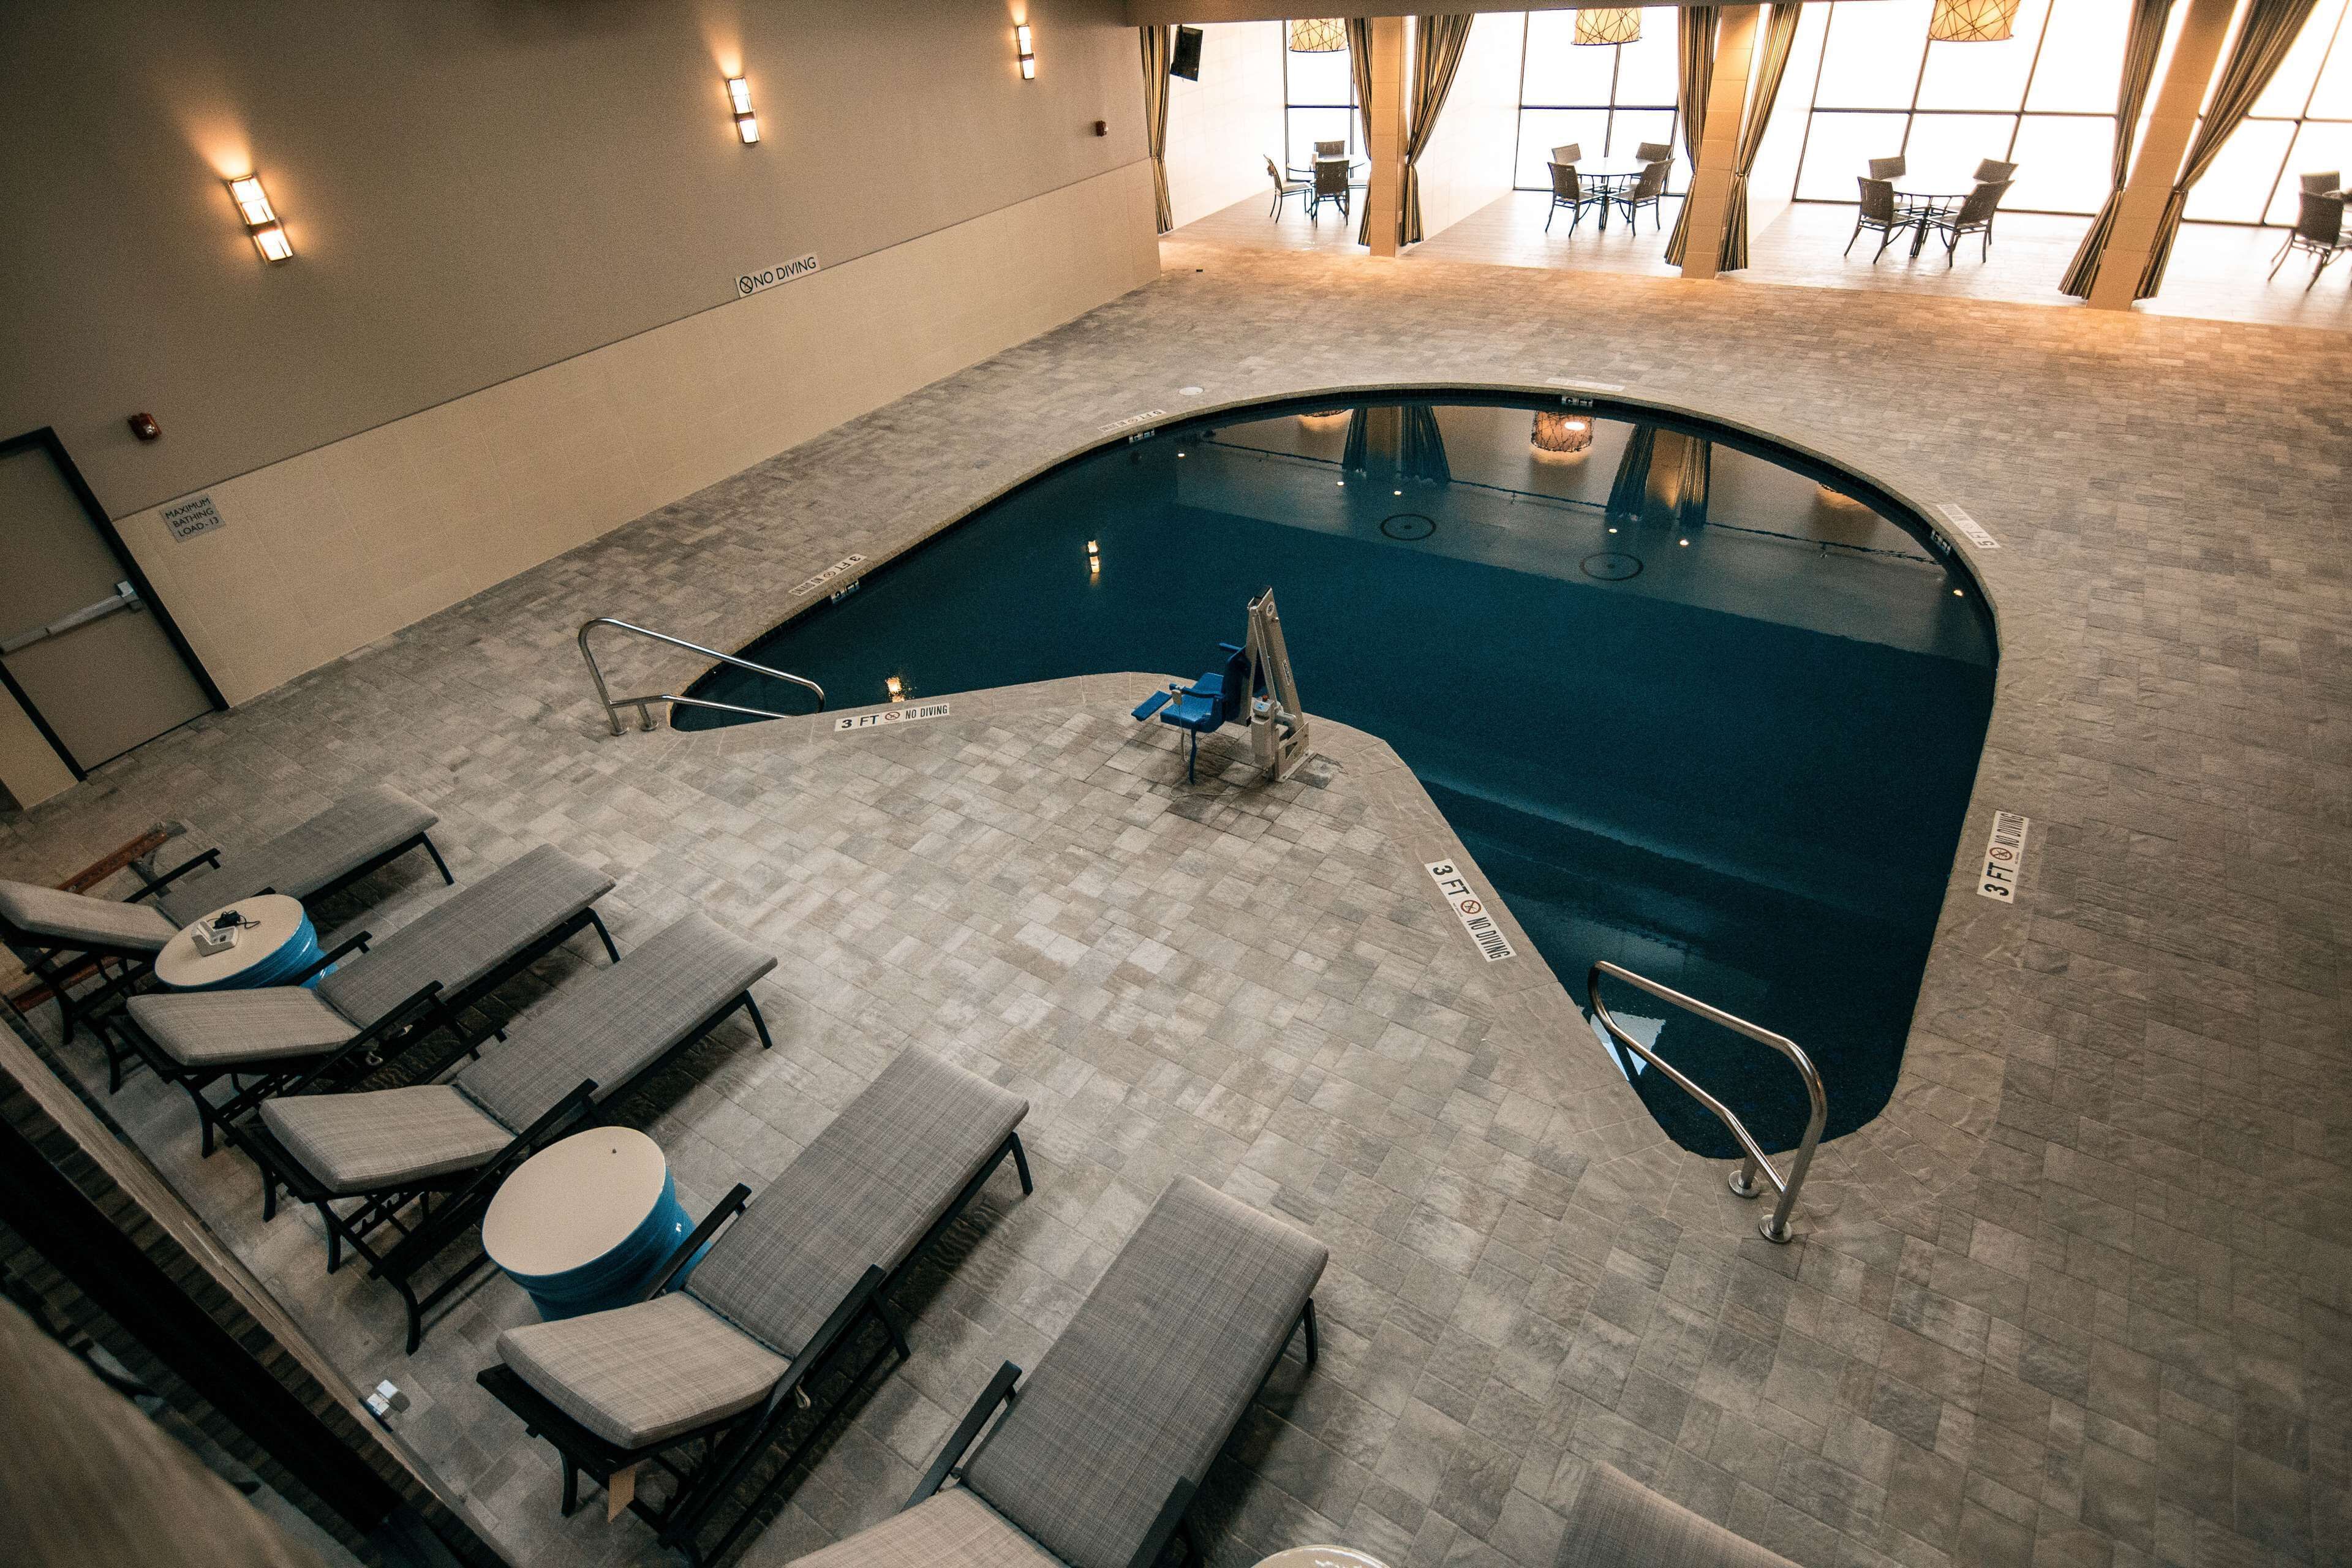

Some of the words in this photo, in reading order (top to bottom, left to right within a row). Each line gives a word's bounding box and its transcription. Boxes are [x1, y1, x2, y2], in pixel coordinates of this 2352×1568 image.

[753, 271, 774, 288] NO
[776, 257, 816, 280] DIVING
[165, 497, 211, 519] MAXIMUM
[173, 507, 214, 528] BATHING
[835, 562, 851, 571] FT
[841, 718, 853, 729] 3
[859, 714, 880, 726] FT
[905, 709, 916, 720] NO
[920, 705, 948, 718] DIVING
[1997, 813, 2024, 837] DIVING
[1994, 835, 2020, 848] NO
[1432, 865, 1453, 876] 3
[1986, 861, 2013, 883] FT
[1441, 878, 1470, 895] FT
[1984, 883, 2009, 896] 3
[1466, 916, 1491, 930] NO
[1475, 930, 1511, 959] DIVING
